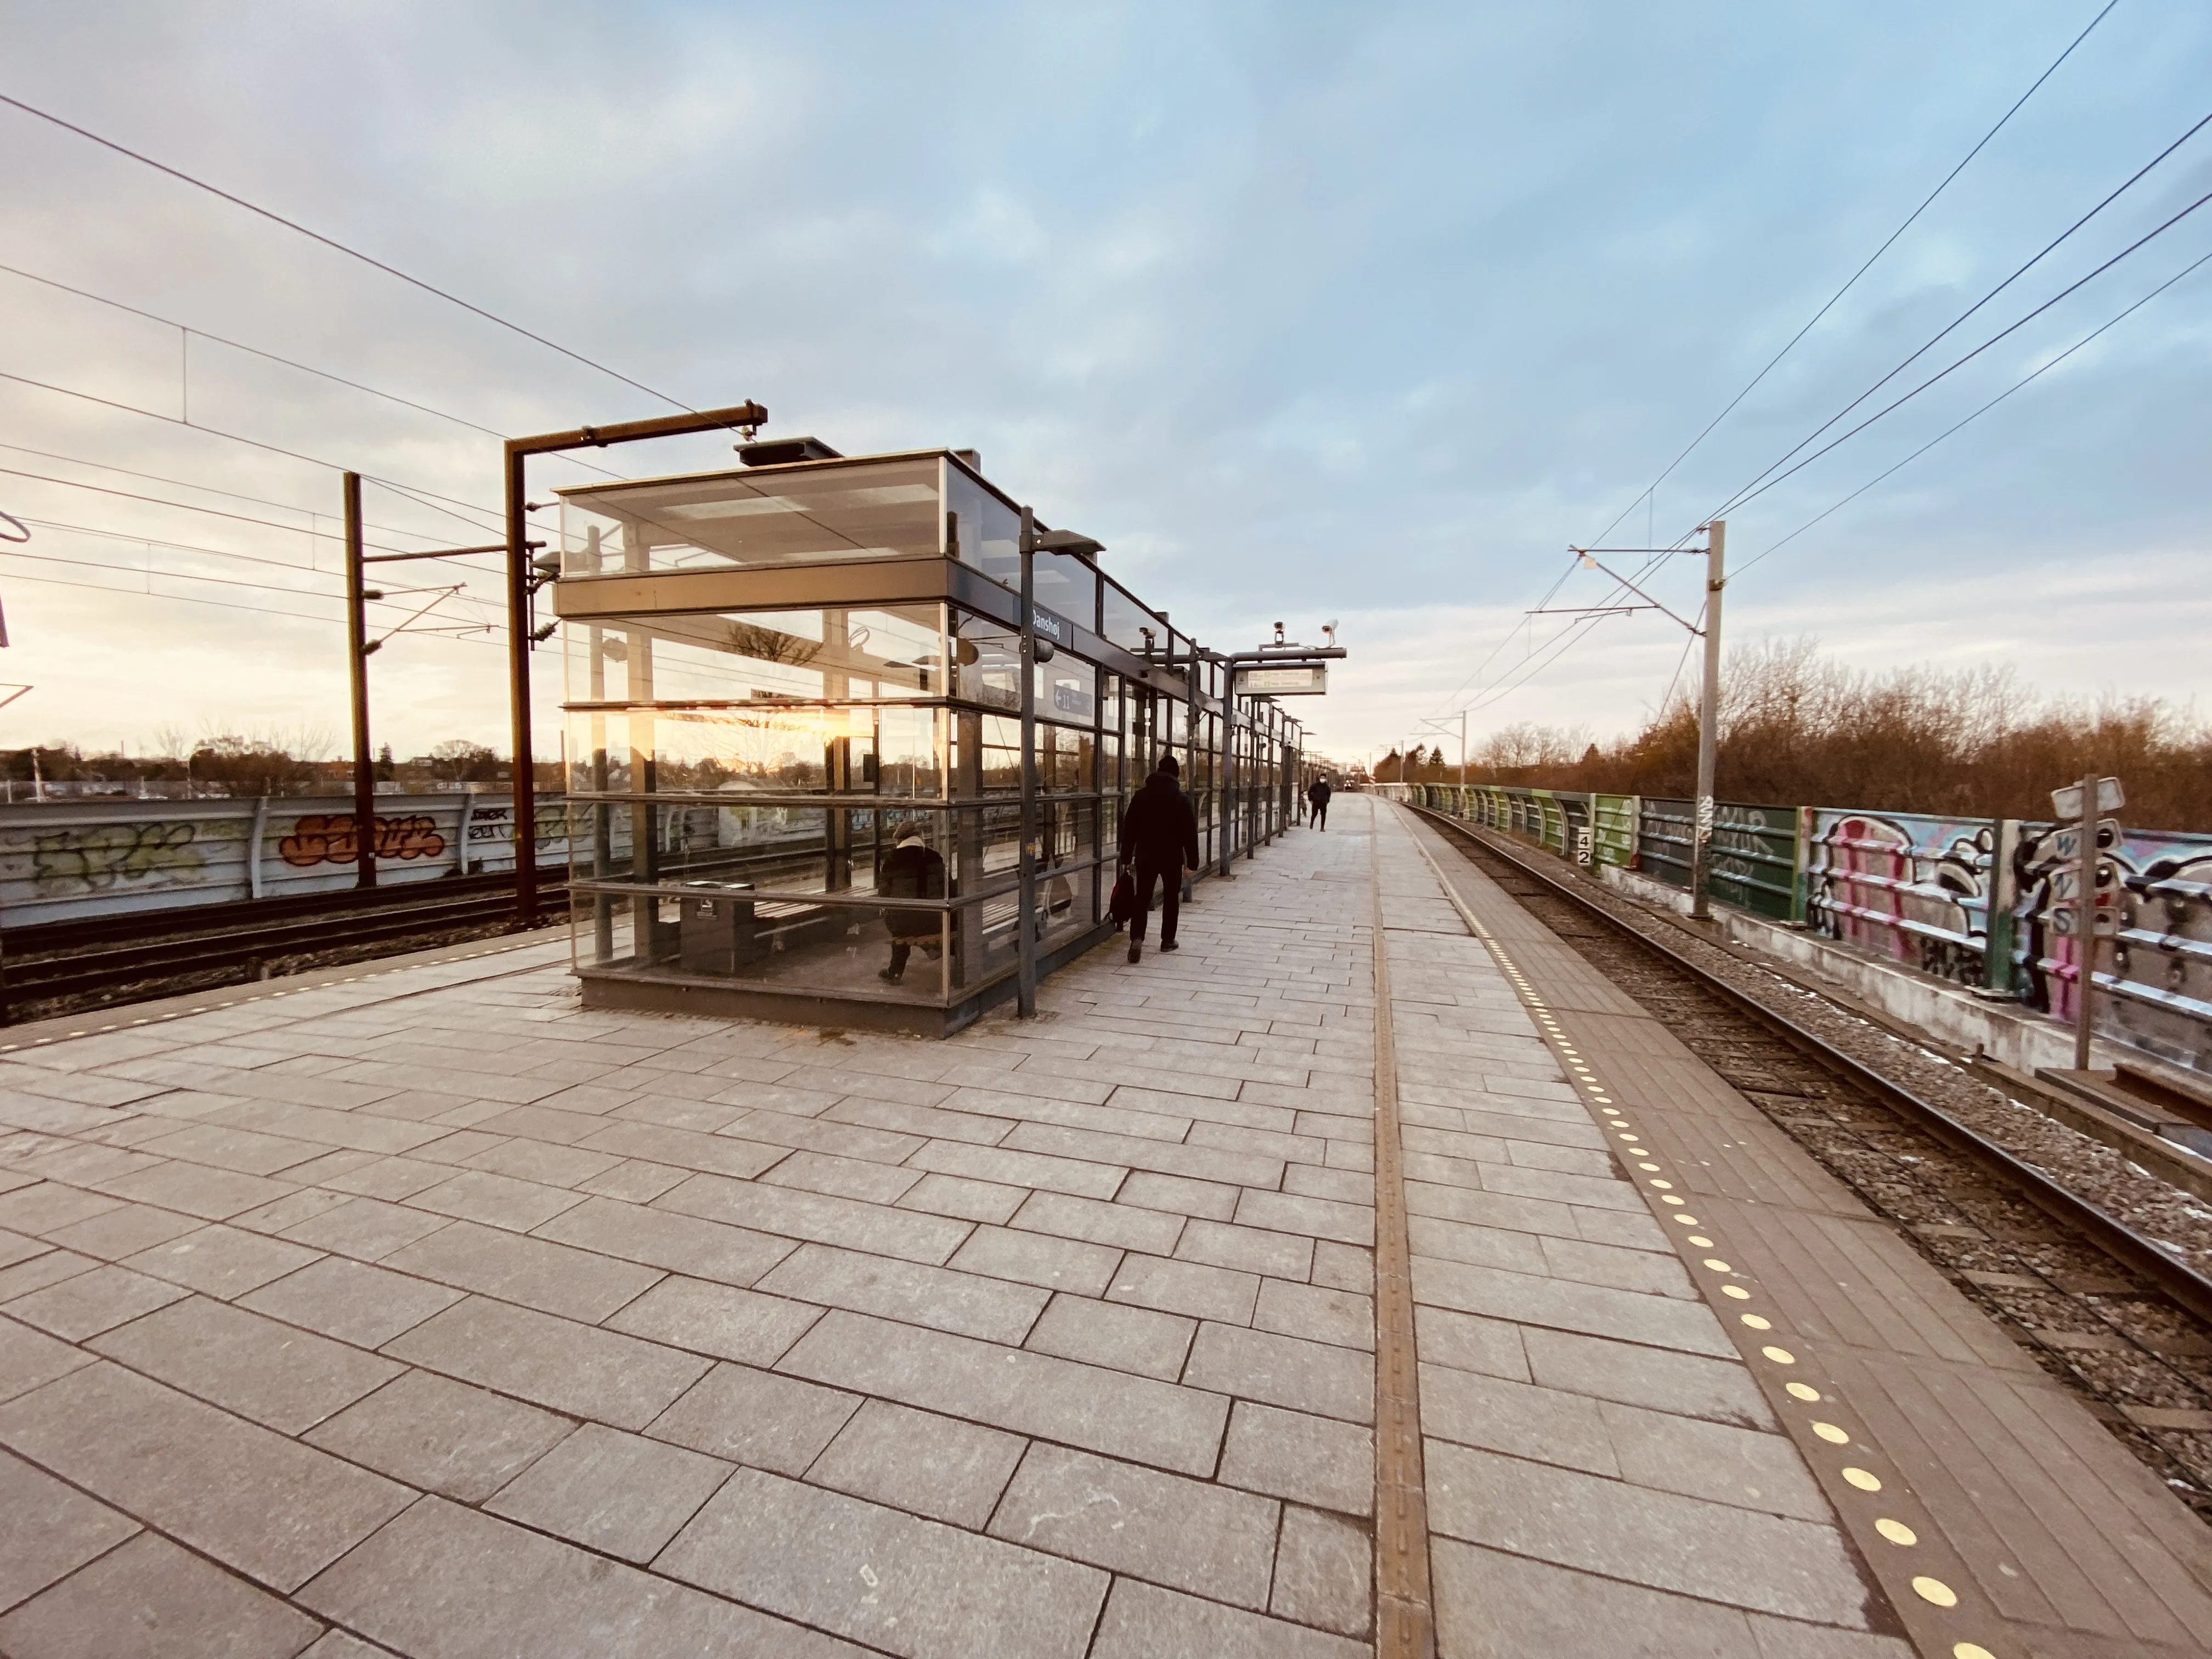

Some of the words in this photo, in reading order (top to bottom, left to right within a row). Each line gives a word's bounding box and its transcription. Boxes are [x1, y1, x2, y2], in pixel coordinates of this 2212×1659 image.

[1063, 693, 1070, 709] 11
[1579, 836, 1589, 847] 4
[1579, 851, 1589, 864] 2
